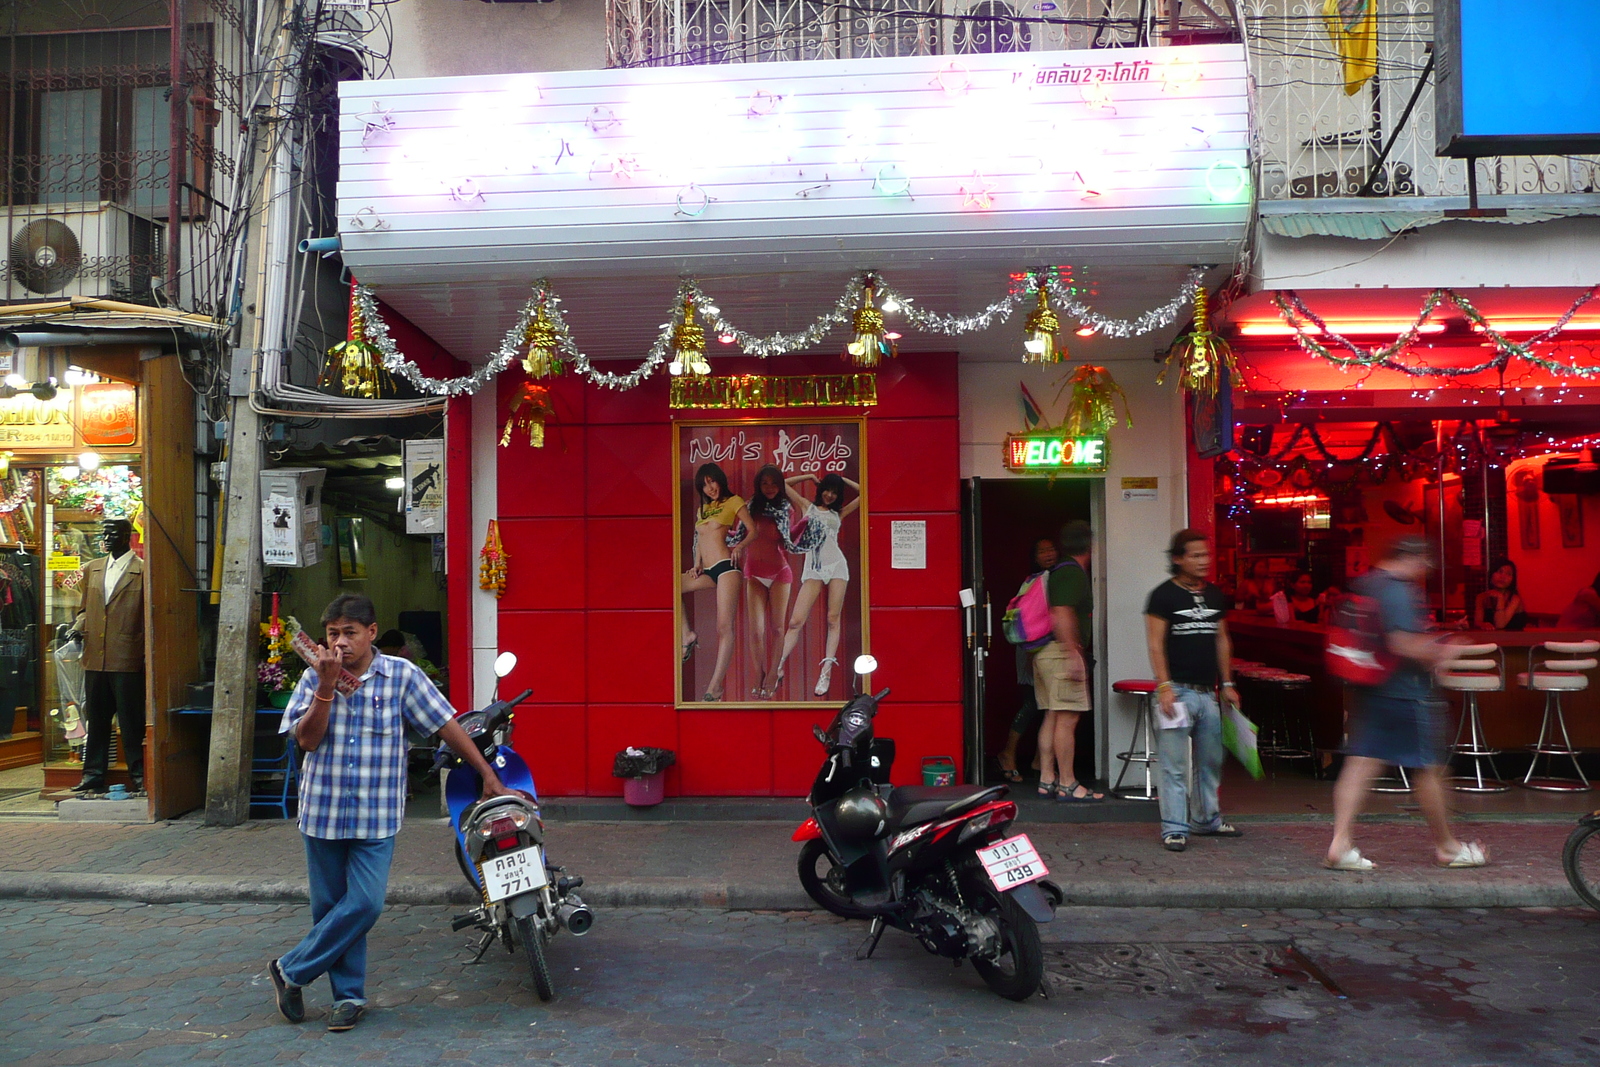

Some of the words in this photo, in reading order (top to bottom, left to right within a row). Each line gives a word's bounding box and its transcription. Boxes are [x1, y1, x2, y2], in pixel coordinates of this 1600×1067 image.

[690, 432, 761, 462] Nui's
[787, 434, 851, 461] Club
[1012, 440, 1104, 465] WELCOME
[785, 462, 794, 472] A
[800, 460, 821, 472] GO
[825, 460, 847, 472] GO
[1006, 865, 1034, 883] 439
[501, 876, 531, 895] 771
